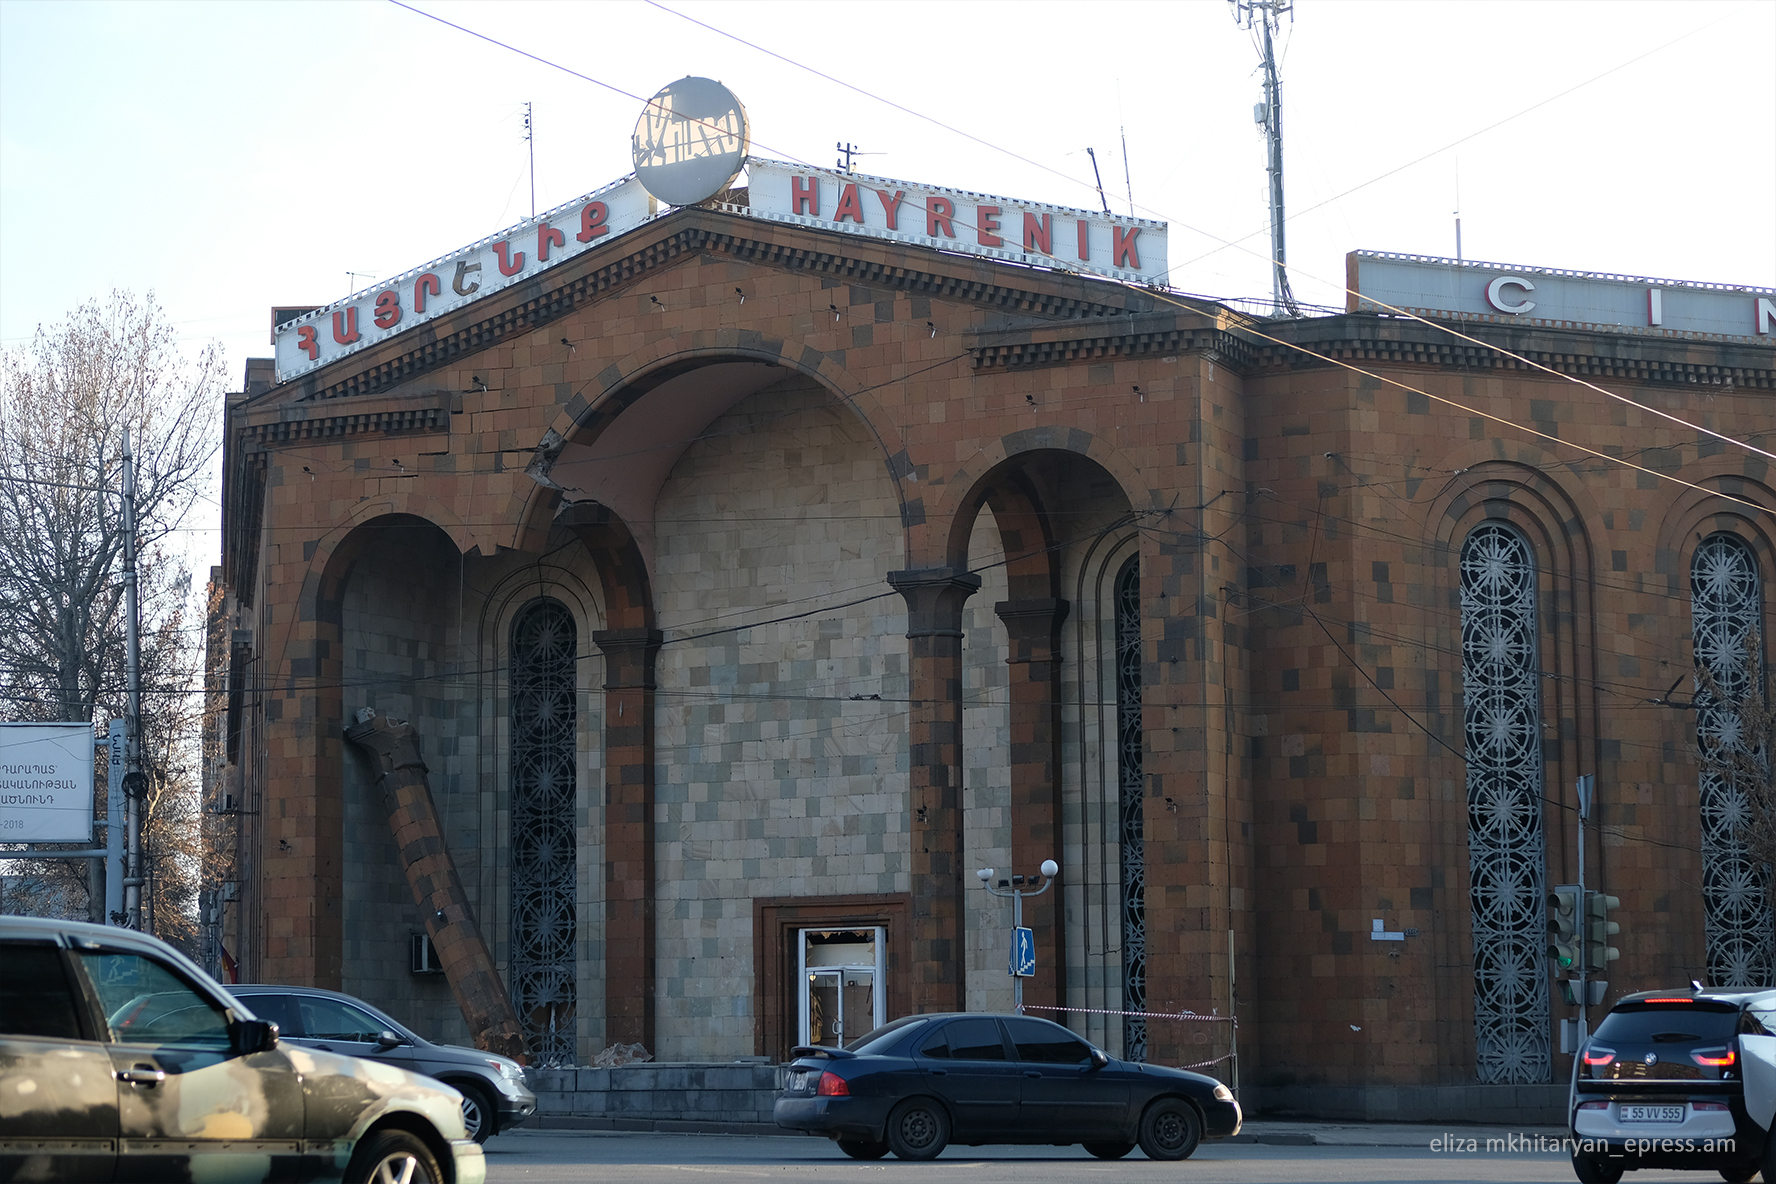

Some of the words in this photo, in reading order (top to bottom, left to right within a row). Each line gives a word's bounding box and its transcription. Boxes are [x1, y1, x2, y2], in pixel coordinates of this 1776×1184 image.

[791, 175, 1143, 269] HAYRENIK
[297, 200, 610, 361] ՀԱՅՐԵՆԻՔ
[1632, 1107, 1644, 1118] 55
[1646, 1107, 1661, 1119] VV
[1662, 1107, 1680, 1119] 555
